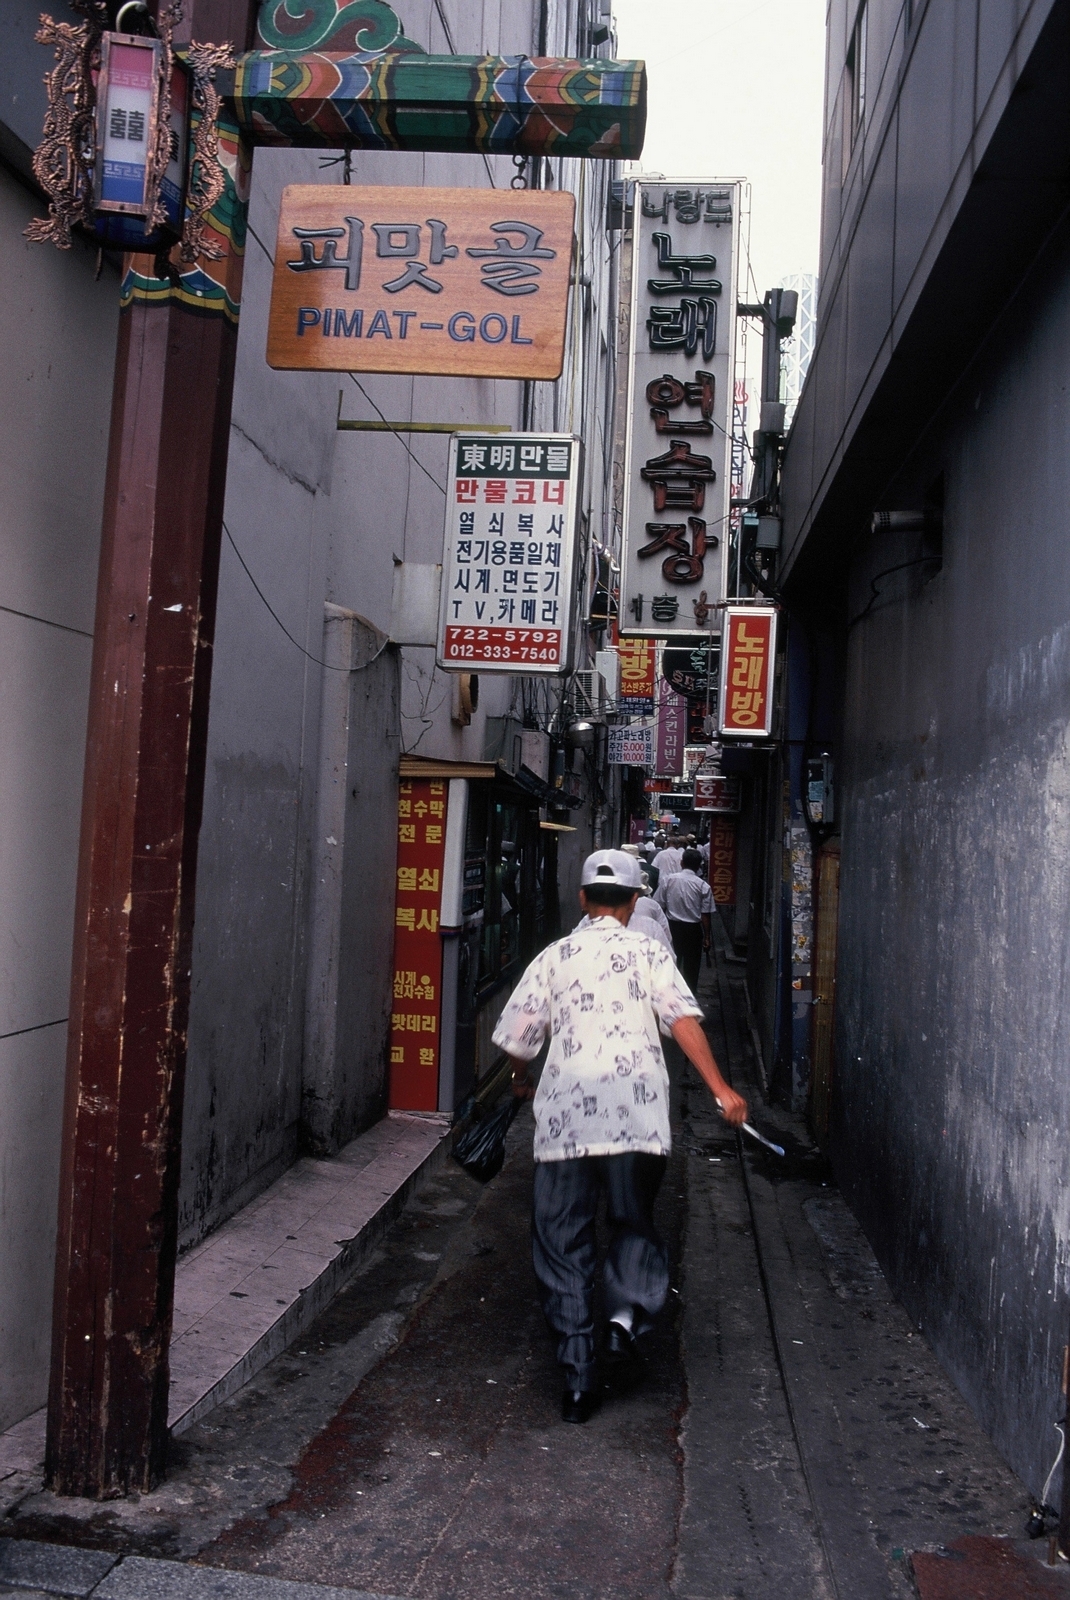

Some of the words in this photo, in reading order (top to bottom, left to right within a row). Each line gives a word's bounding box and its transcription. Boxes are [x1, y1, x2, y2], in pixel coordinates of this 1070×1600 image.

[286, 216, 557, 297] 피맛골
[296, 307, 533, 345] PIMAT-GOL
[637, 232, 722, 583] 노래연습장
[456, 479, 565, 505] 만물코너
[456, 540, 560, 567] 전기용품일체
[450, 628, 558, 643] 722-5792
[450, 644, 557, 660] 012-333-7540
[731, 622, 764, 726] 노래방
[609, 730, 651, 742] 가고파노래방
[663, 696, 679, 773] 배스킨라빈스
[398, 799, 444, 819] 현수막
[398, 824, 442, 844] 전문
[713, 816, 736, 902] 노래연습장
[397, 867, 439, 892] 열쇠
[395, 907, 439, 932] 복사
[393, 971, 417, 985] 시계
[393, 984, 435, 1000] 전자수첩
[391, 1013, 436, 1033] 밧데리
[390, 1046, 435, 1066] 교환
